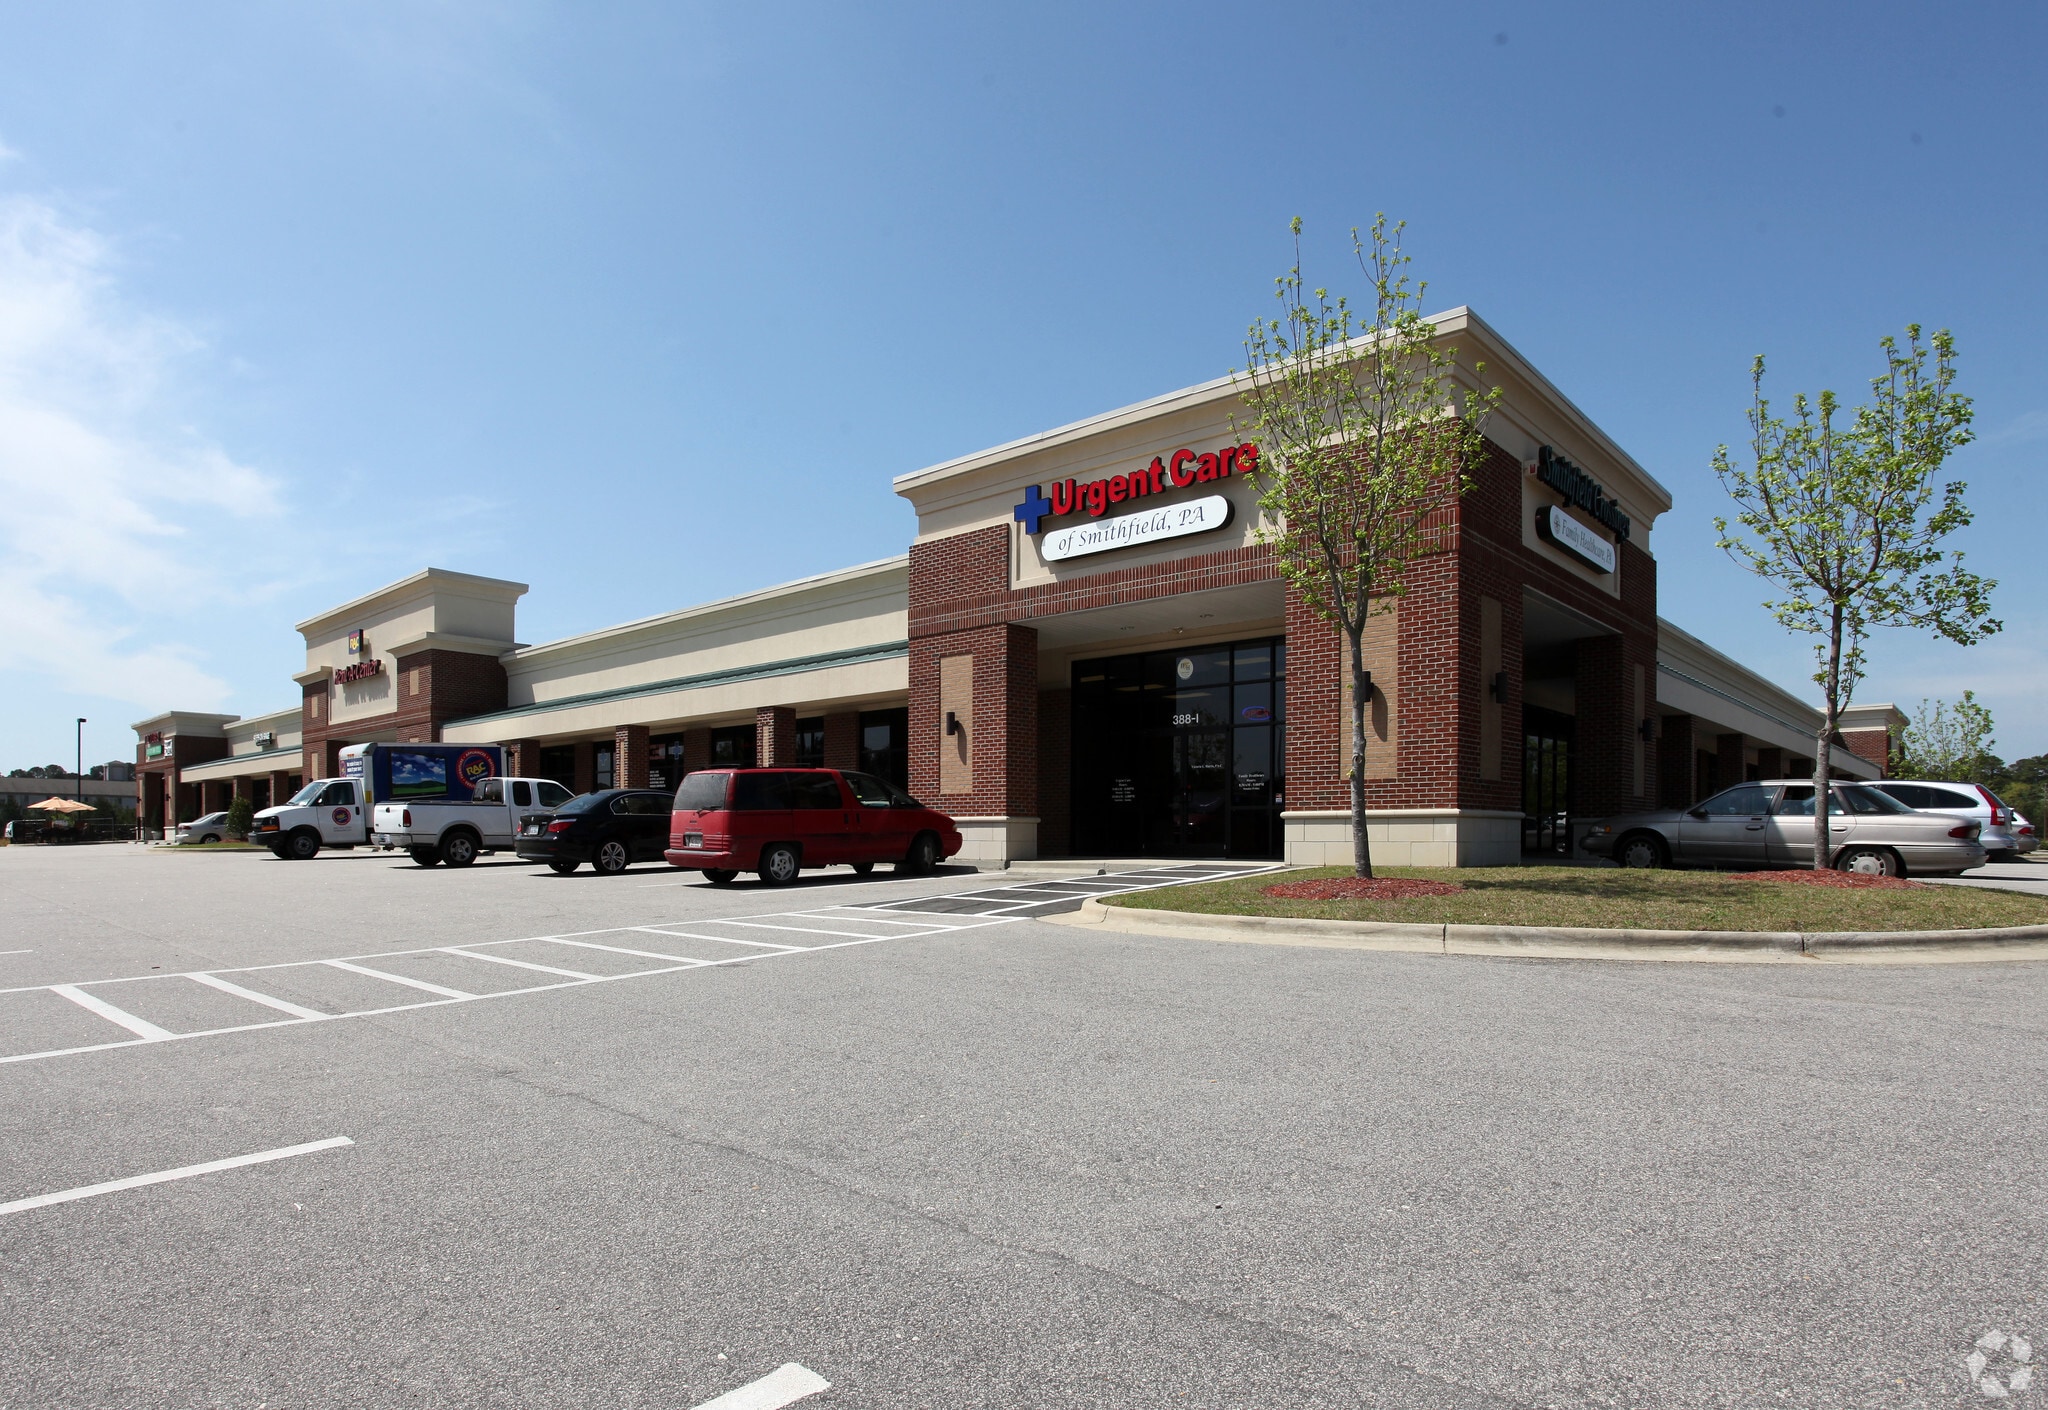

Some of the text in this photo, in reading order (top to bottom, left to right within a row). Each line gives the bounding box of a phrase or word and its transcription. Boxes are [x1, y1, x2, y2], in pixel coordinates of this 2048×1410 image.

[1051, 442, 1259, 517] Urgent Care
[1058, 505, 1206, 556] of Smithfield, PA
[1562, 519, 1580, 548] Family
[465, 762, 486, 776] RAC
